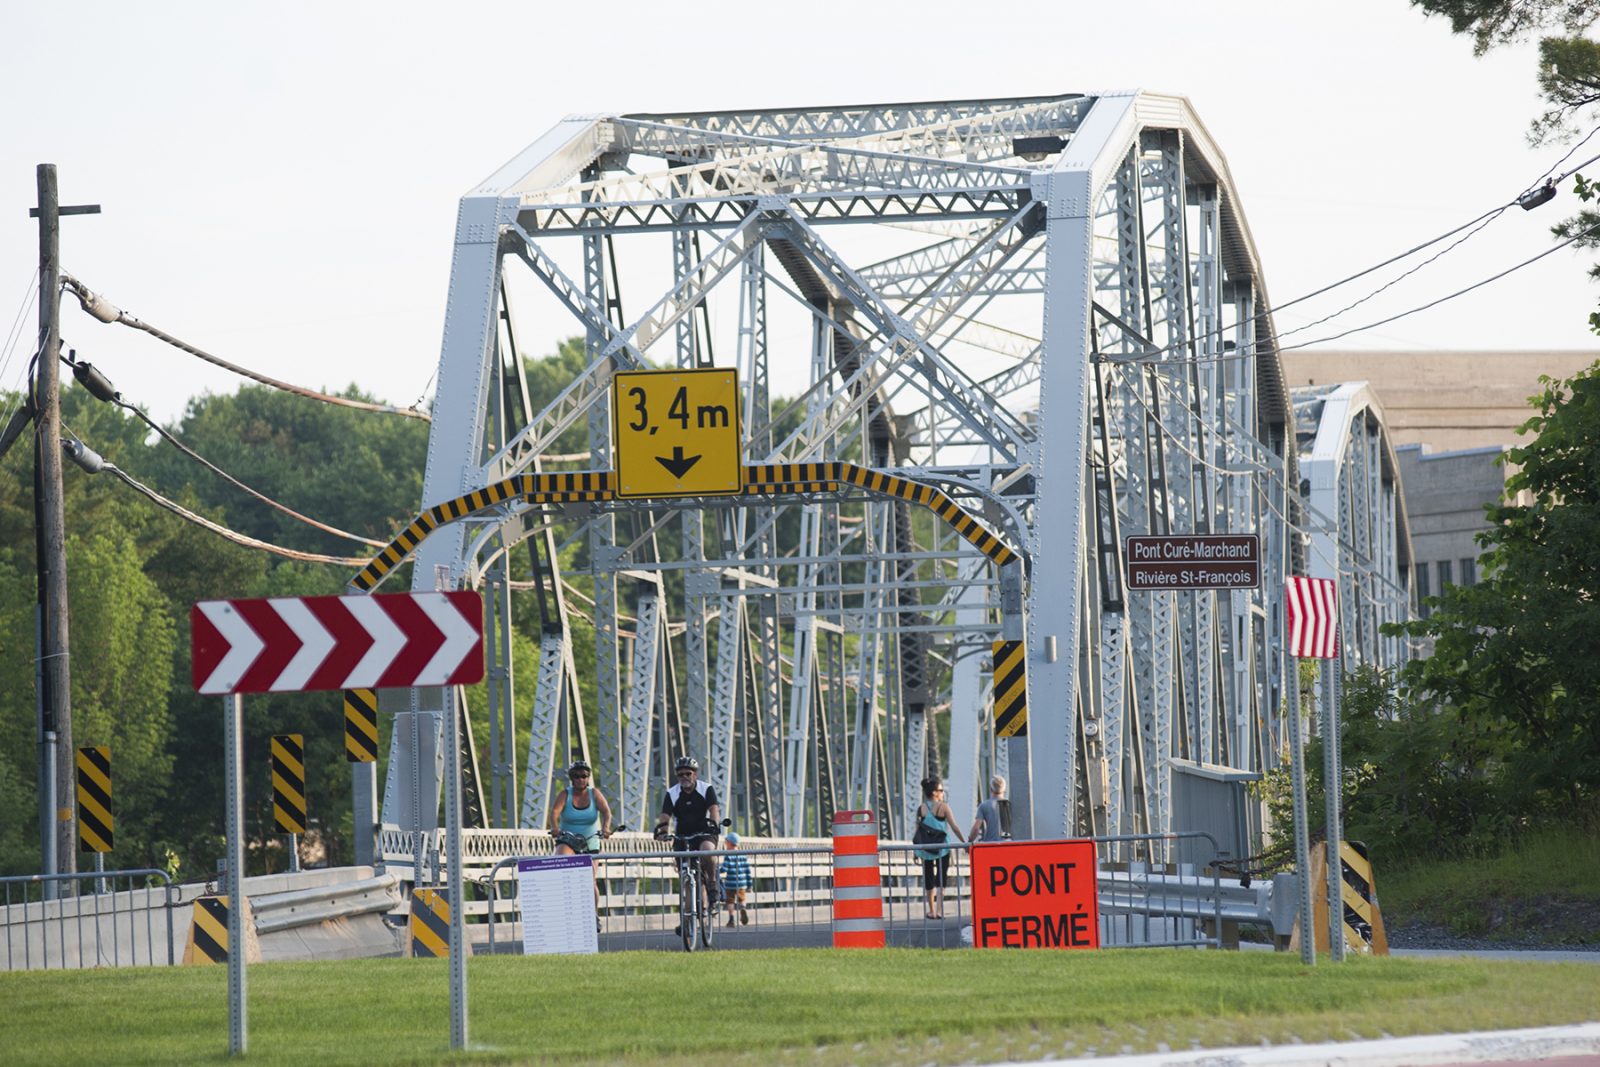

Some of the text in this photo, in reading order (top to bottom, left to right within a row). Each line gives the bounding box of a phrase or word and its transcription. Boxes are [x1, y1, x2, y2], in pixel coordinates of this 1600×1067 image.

[1135, 541, 1250, 558] Pont Curé-Marchand
[1136, 569, 1251, 586] Rivière St-François
[990, 863, 1076, 897] PONT
[981, 903, 1090, 949] FERMÉ
